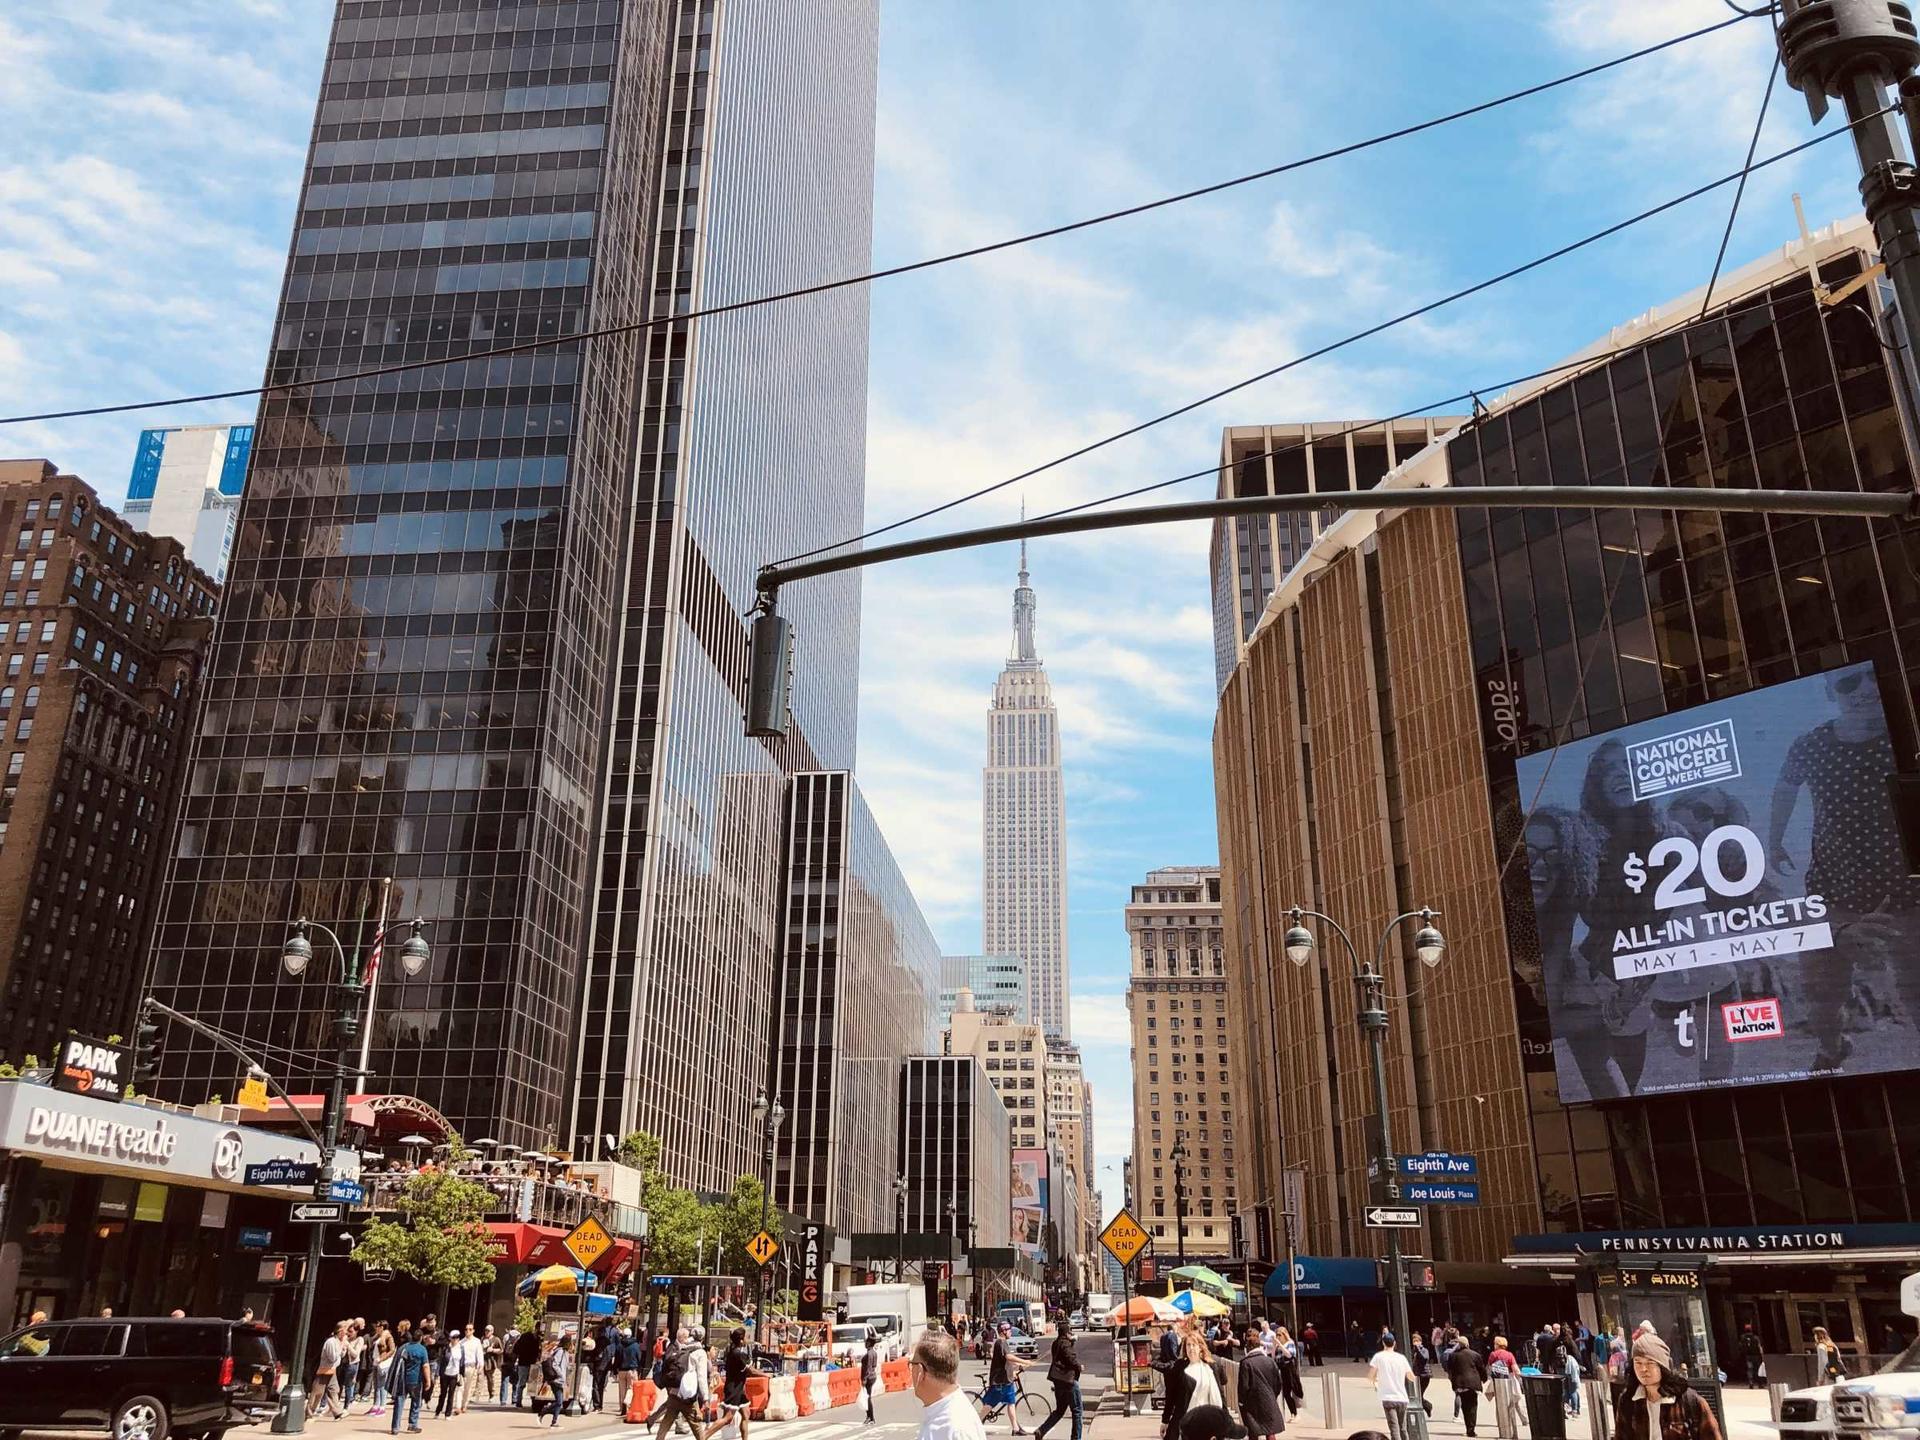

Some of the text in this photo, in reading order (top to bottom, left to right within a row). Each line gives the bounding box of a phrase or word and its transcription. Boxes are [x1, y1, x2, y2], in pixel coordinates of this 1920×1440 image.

[1636, 728, 1727, 764] NATIONAL
[1637, 743, 1729, 781] CONCERT
[1667, 768, 1702, 786] WEEK
[1622, 824, 1766, 911] $20
[1612, 894, 1828, 952] ALL-IN TICKETS
[1633, 952, 1677, 972] MAY
[1690, 949, 1698, 963] 1
[1729, 935, 1779, 957] MAY
[1793, 932, 1805, 947] 7
[1729, 1006, 1773, 1025] LIVE
[1673, 1008, 1694, 1047] t
[1732, 1021, 1776, 1034] NATION
[66, 1041, 121, 1075] PARK
[92, 1076, 107, 1090] 24
[215, 1138, 242, 1171] DR
[251, 1168, 306, 1182] Eighth Ave
[1407, 1159, 1470, 1173] Eighth Ave
[332, 1185, 345, 1198] West
[1410, 1188, 1427, 1199] Joe
[1429, 1187, 1455, 1199] Louis
[299, 1208, 313, 1216] ONE
[576, 1231, 602, 1241] DEAD
[1111, 1228, 1138, 1238] DEAD
[1602, 1232, 1843, 1250] PENNSYLVANIA STATION
[578, 1244, 598, 1254] END
[804, 1226, 819, 1280] PARK
[1115, 1241, 1134, 1251] END
[1294, 1263, 1305, 1281] D
[1662, 1274, 1689, 1285] TAXI
